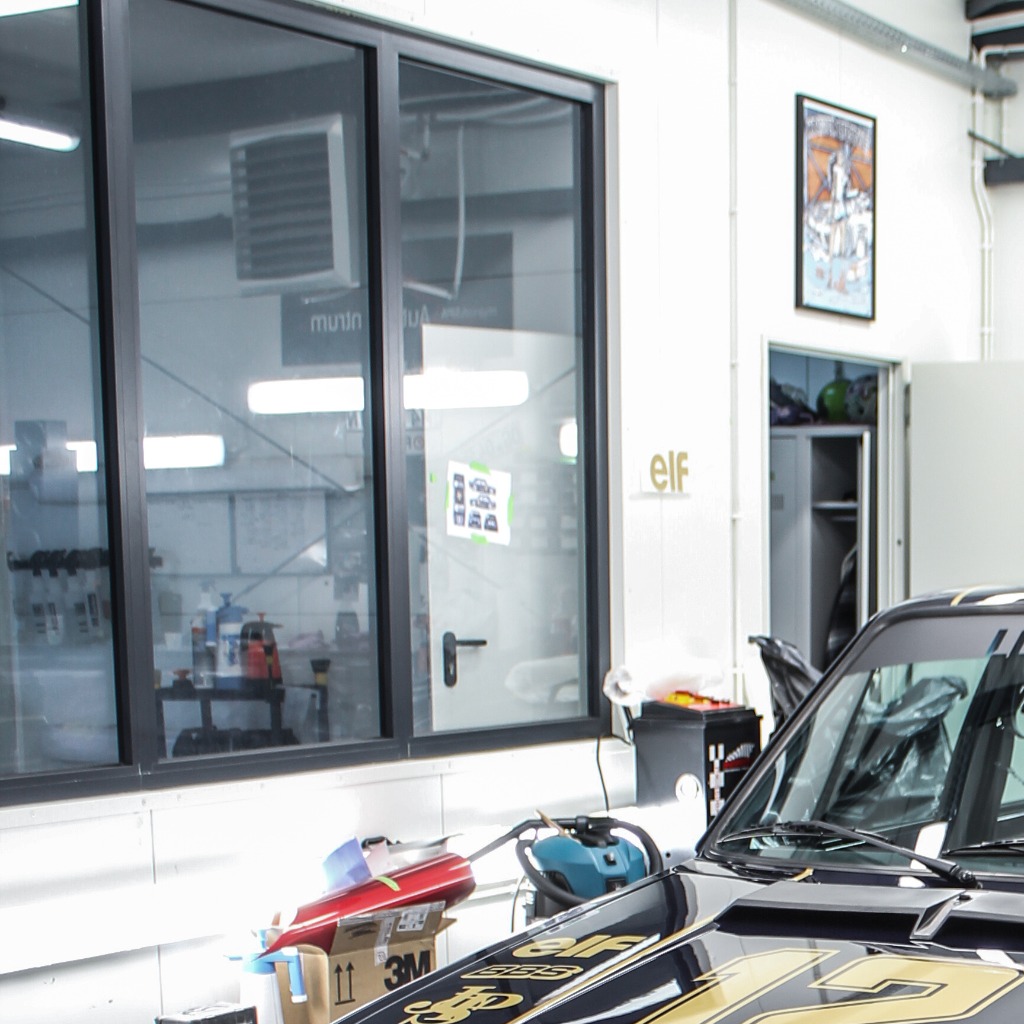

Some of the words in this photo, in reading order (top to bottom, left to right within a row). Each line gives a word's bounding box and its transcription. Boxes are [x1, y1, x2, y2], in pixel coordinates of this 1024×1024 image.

[650, 450, 689, 492] elf
[512, 935, 647, 958] elf
[384, 950, 431, 991] 3M
[461, 965, 584, 980] BBS
